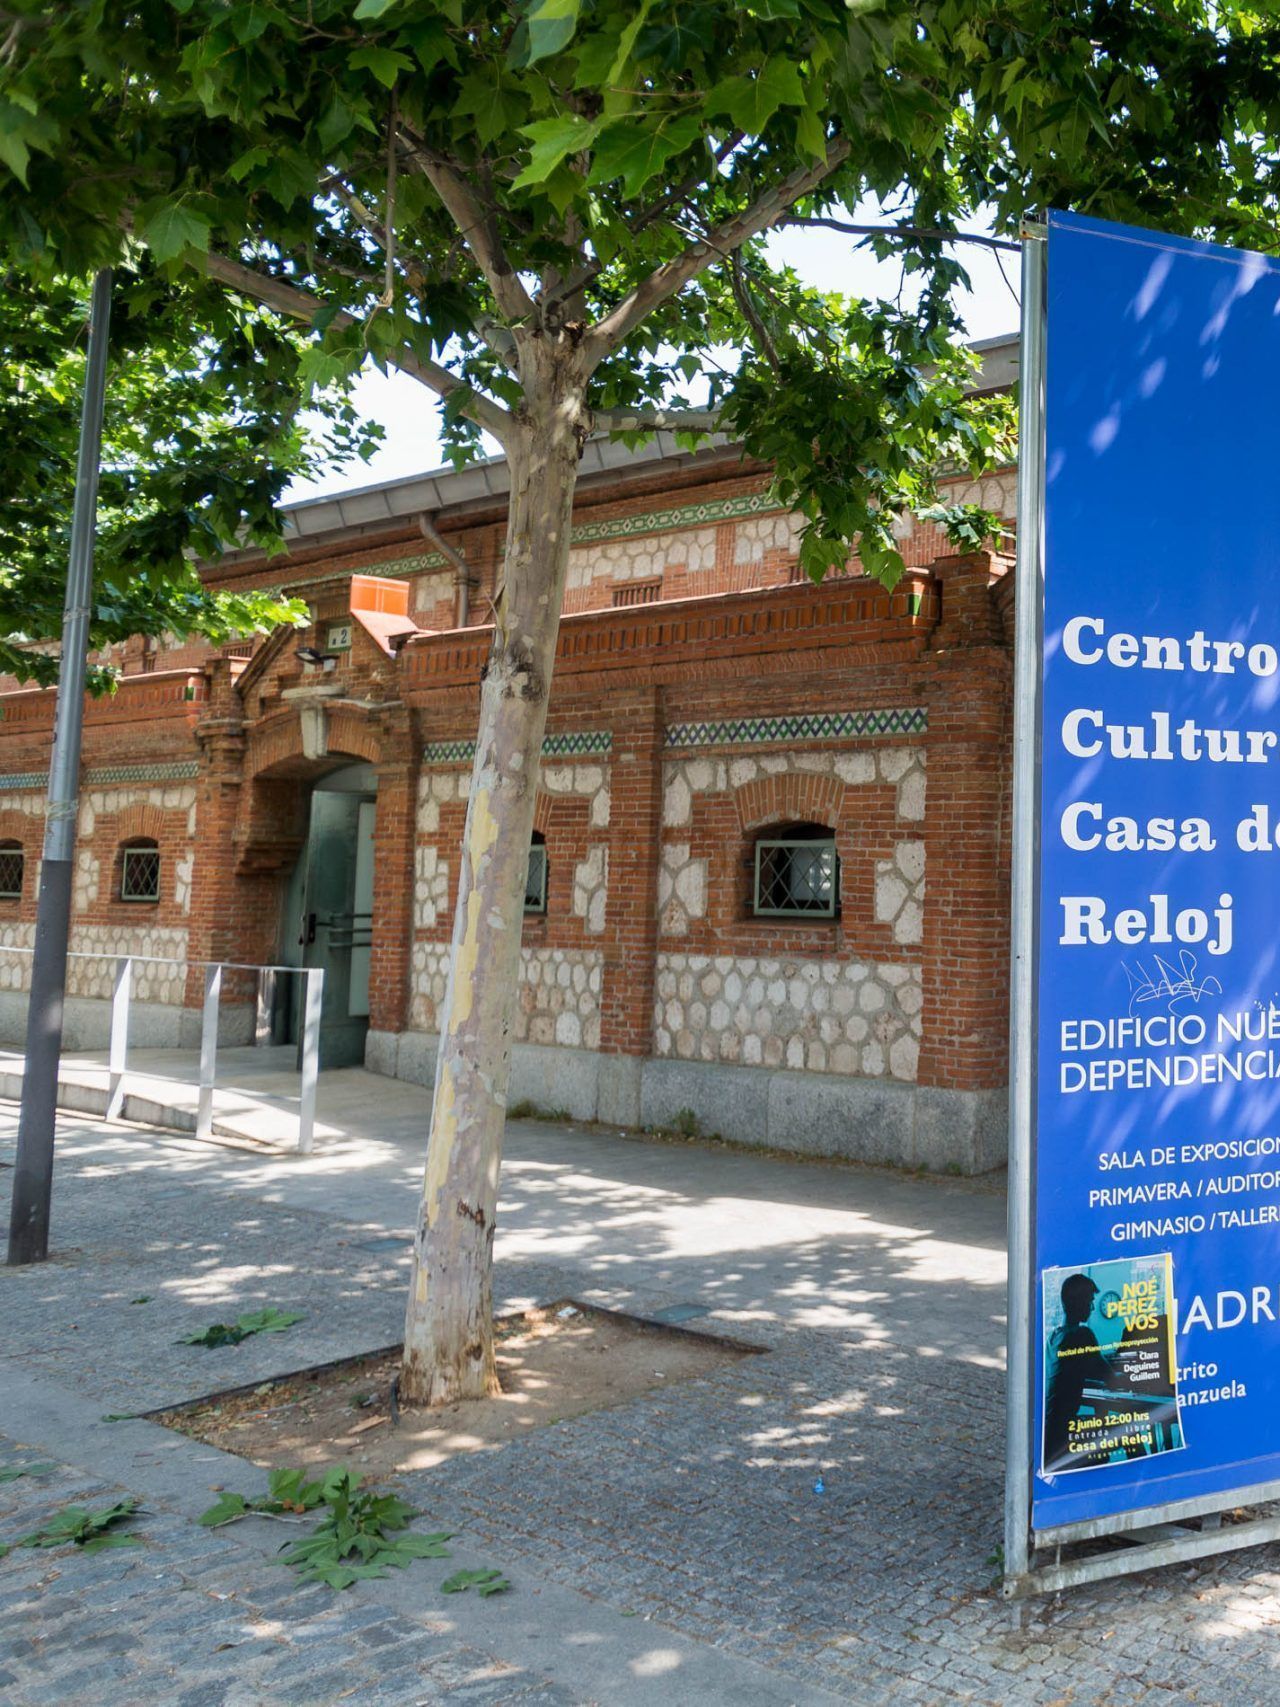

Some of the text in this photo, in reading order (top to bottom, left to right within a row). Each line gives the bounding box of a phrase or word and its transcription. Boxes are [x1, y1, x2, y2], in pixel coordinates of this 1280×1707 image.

[1062, 616, 1278, 677] Centro
[1060, 802, 1217, 852] Casa
[1059, 893, 1233, 955] Reloj
[1061, 1014, 1206, 1052] EDIFICIO
[1099, 1150, 1146, 1171] SALA
[1151, 1147, 1176, 1166] DE
[1089, 1181, 1192, 1208] PRIMAVERA
[1110, 1214, 1206, 1242] GIMNASIO
[1123, 1275, 1158, 1299] NOÉ
[1124, 1313, 1159, 1332] VOS
[1139, 1351, 1159, 1360] Clara
[1129, 1372, 1160, 1382] Guillem
[1176, 1362, 1218, 1382] trito
[1177, 1379, 1247, 1408] anzuela
[1068, 1411, 1150, 1433] 2 junio 12:00 hrs
[1068, 1424, 1151, 1441] Entrada libre
[1068, 1431, 1153, 1453] Casa del Reloj
